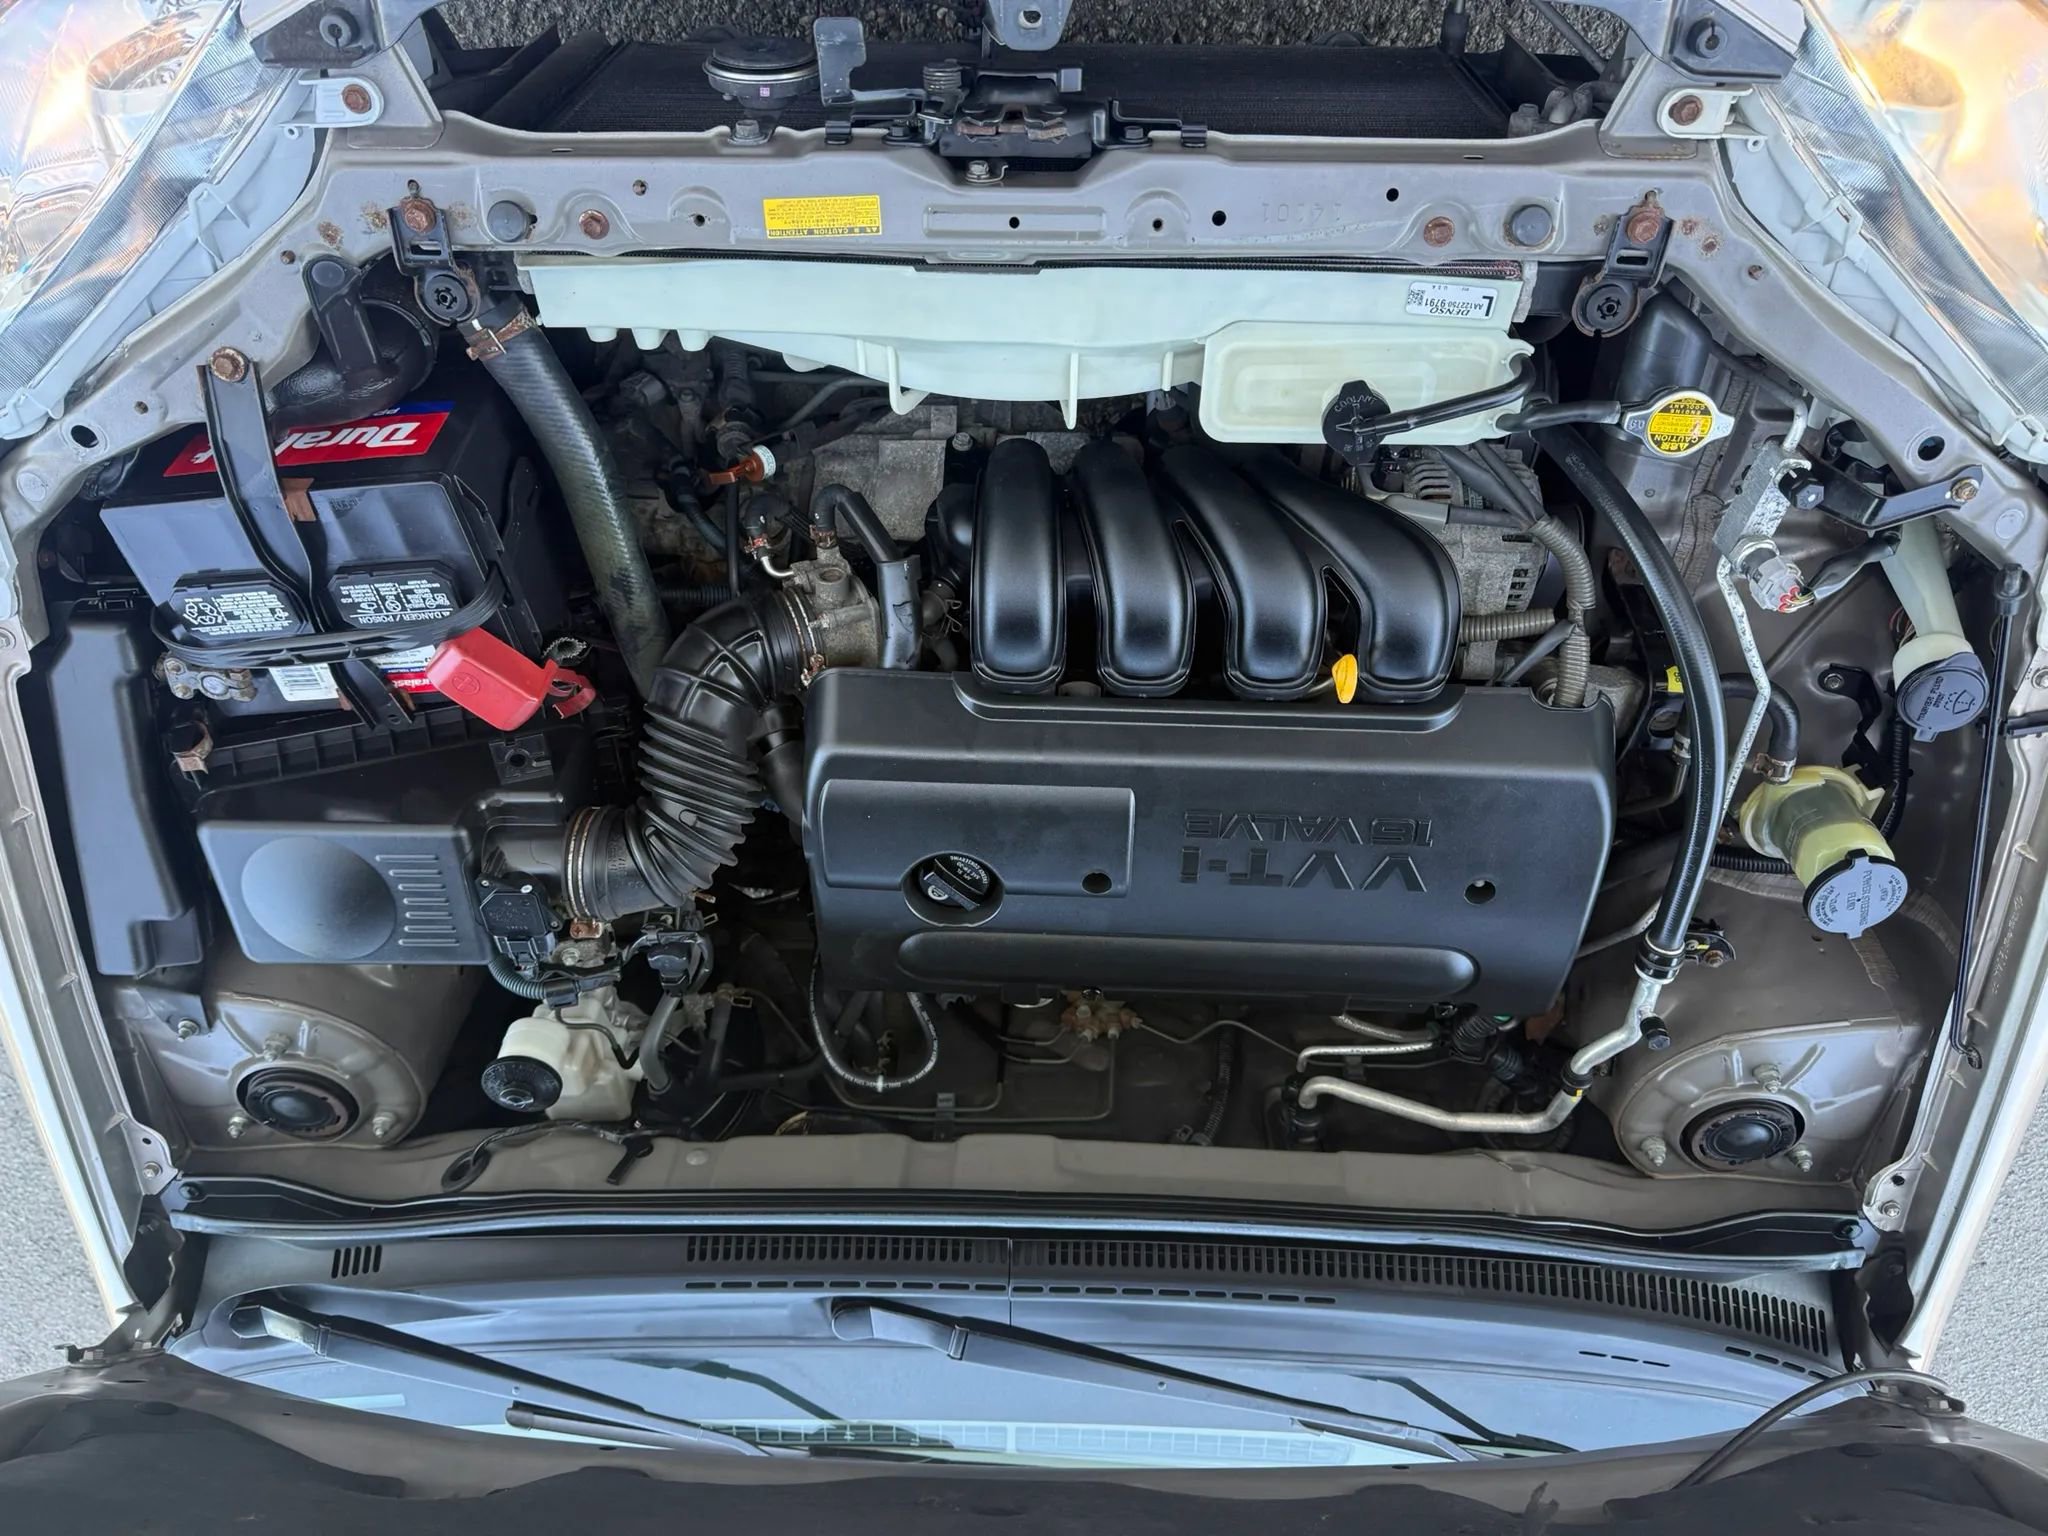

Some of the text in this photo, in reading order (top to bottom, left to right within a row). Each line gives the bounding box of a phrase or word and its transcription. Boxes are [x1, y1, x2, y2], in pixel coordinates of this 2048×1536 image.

[767, 228, 808, 236] ATTENTION
[814, 227, 848, 235] CAUTION
[1429, 307, 1471, 316] DENSO
[1482, 296, 1494, 317] L
[1654, 434, 1698, 443] CAUTION
[358, 614, 393, 625] POISON
[400, 610, 442, 622] DANGER
[1183, 813, 1433, 848] 16 VALVE
[1859, 870, 1873, 926] POWER STEERING
